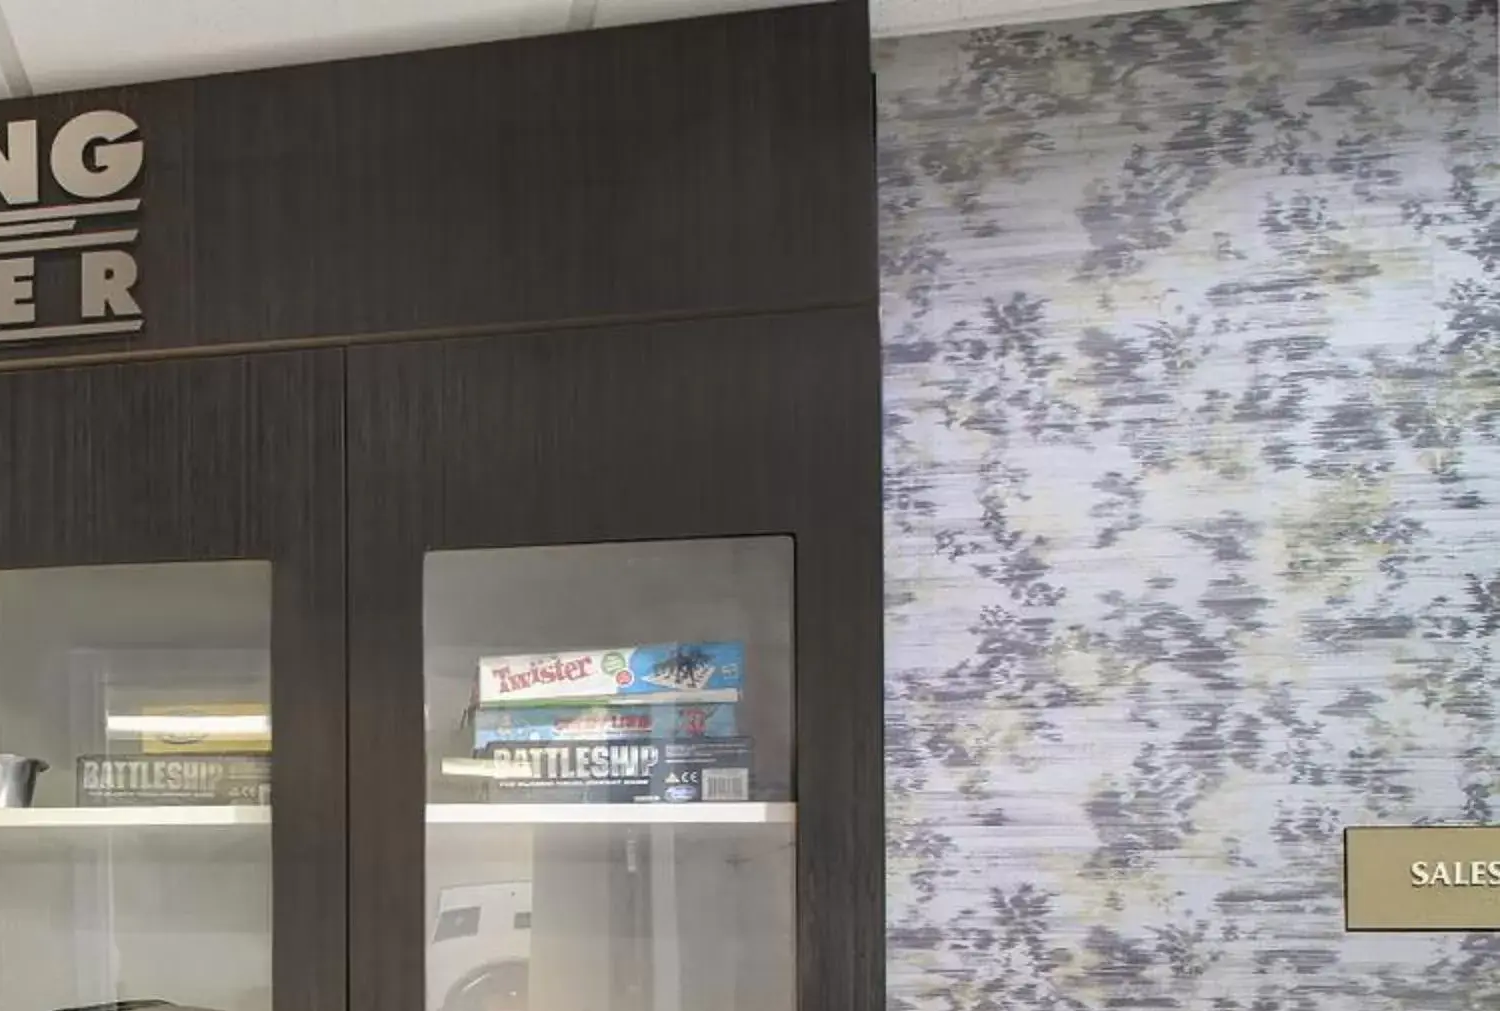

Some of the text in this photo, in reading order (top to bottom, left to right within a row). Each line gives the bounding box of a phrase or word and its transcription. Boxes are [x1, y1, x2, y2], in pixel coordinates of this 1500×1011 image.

[83, 760, 224, 790] BATTLESHIP
[492, 744, 660, 779] BATTLESHIP
[1410, 861, 1500, 886] SALES
